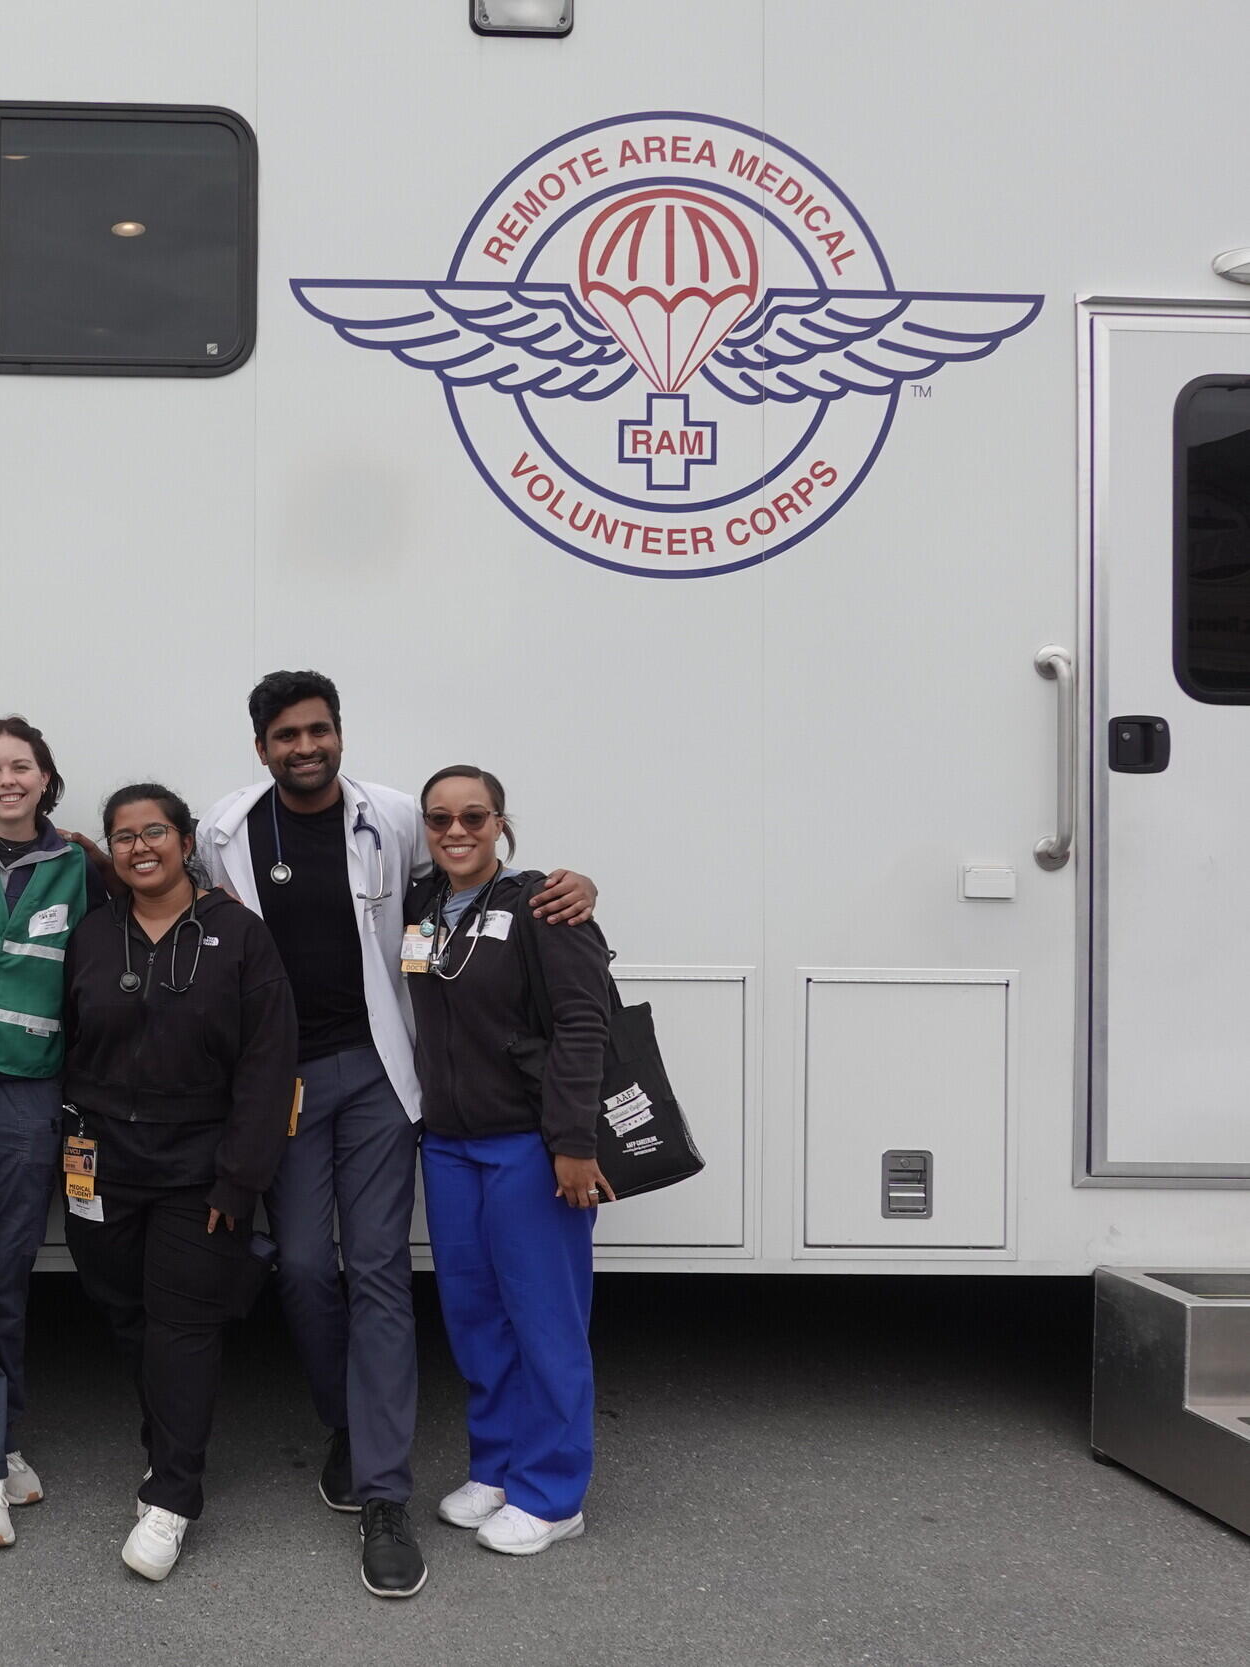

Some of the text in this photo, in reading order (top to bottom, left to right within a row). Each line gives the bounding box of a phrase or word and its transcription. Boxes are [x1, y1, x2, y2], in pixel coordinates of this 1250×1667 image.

[483, 135, 856, 276] REMOTE AREA MEDICAL
[910, 385, 932, 398] TM
[631, 429, 704, 455] RAM
[510, 452, 838, 556] VOLUNTEER CORPS
[68, 1189, 92, 1198] STUDENT
[69, 1184, 92, 1193] MEDICAL
